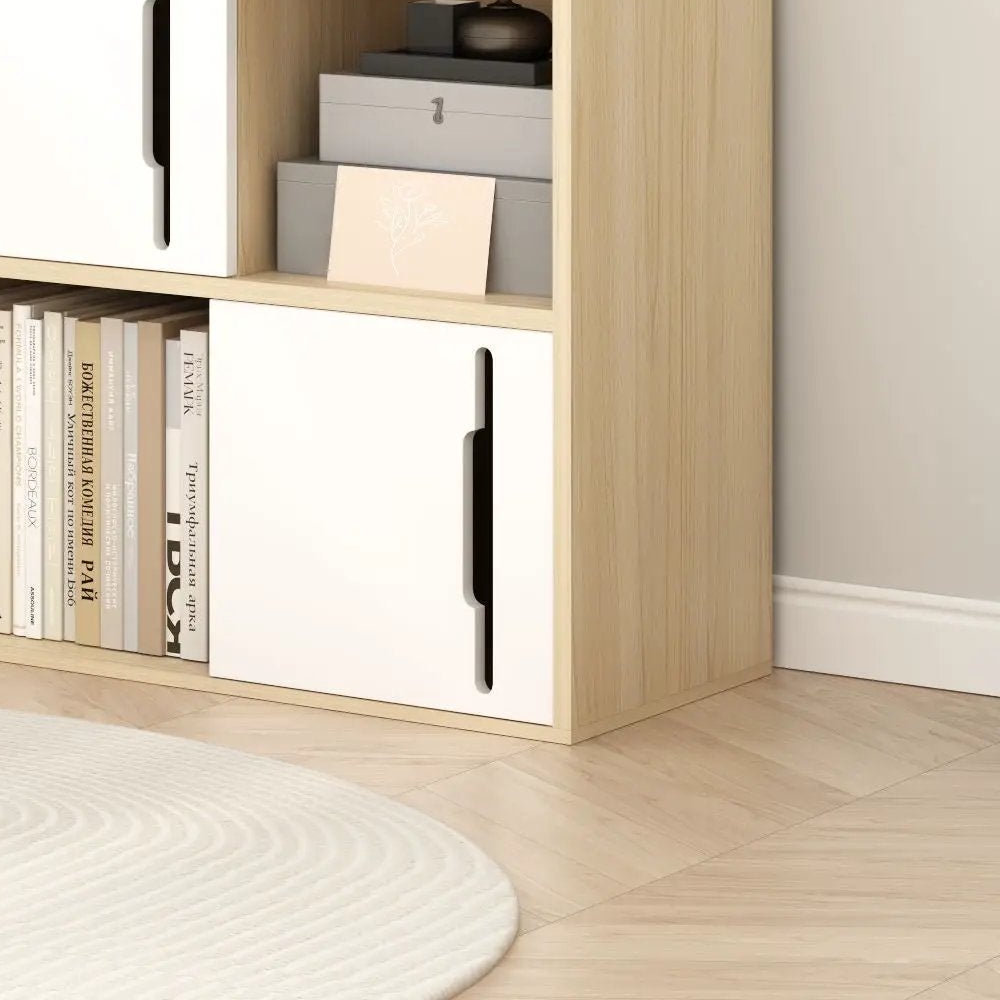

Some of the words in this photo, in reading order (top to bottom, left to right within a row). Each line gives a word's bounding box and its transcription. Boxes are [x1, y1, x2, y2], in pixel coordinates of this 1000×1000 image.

[183, 352, 194, 416] РЕМАРК
[66, 413, 76, 477] Уличный
[81, 361, 94, 475] БОЖЕСТВЕННАЯ
[27, 447, 37, 529] BORDEAUX
[67, 509, 74, 527] по
[81, 478, 94, 547] КОМЕДИЯ
[185, 462, 199, 587] Триумфальная
[81, 559, 98, 602] РАЙ
[186, 594, 196, 632] арка
